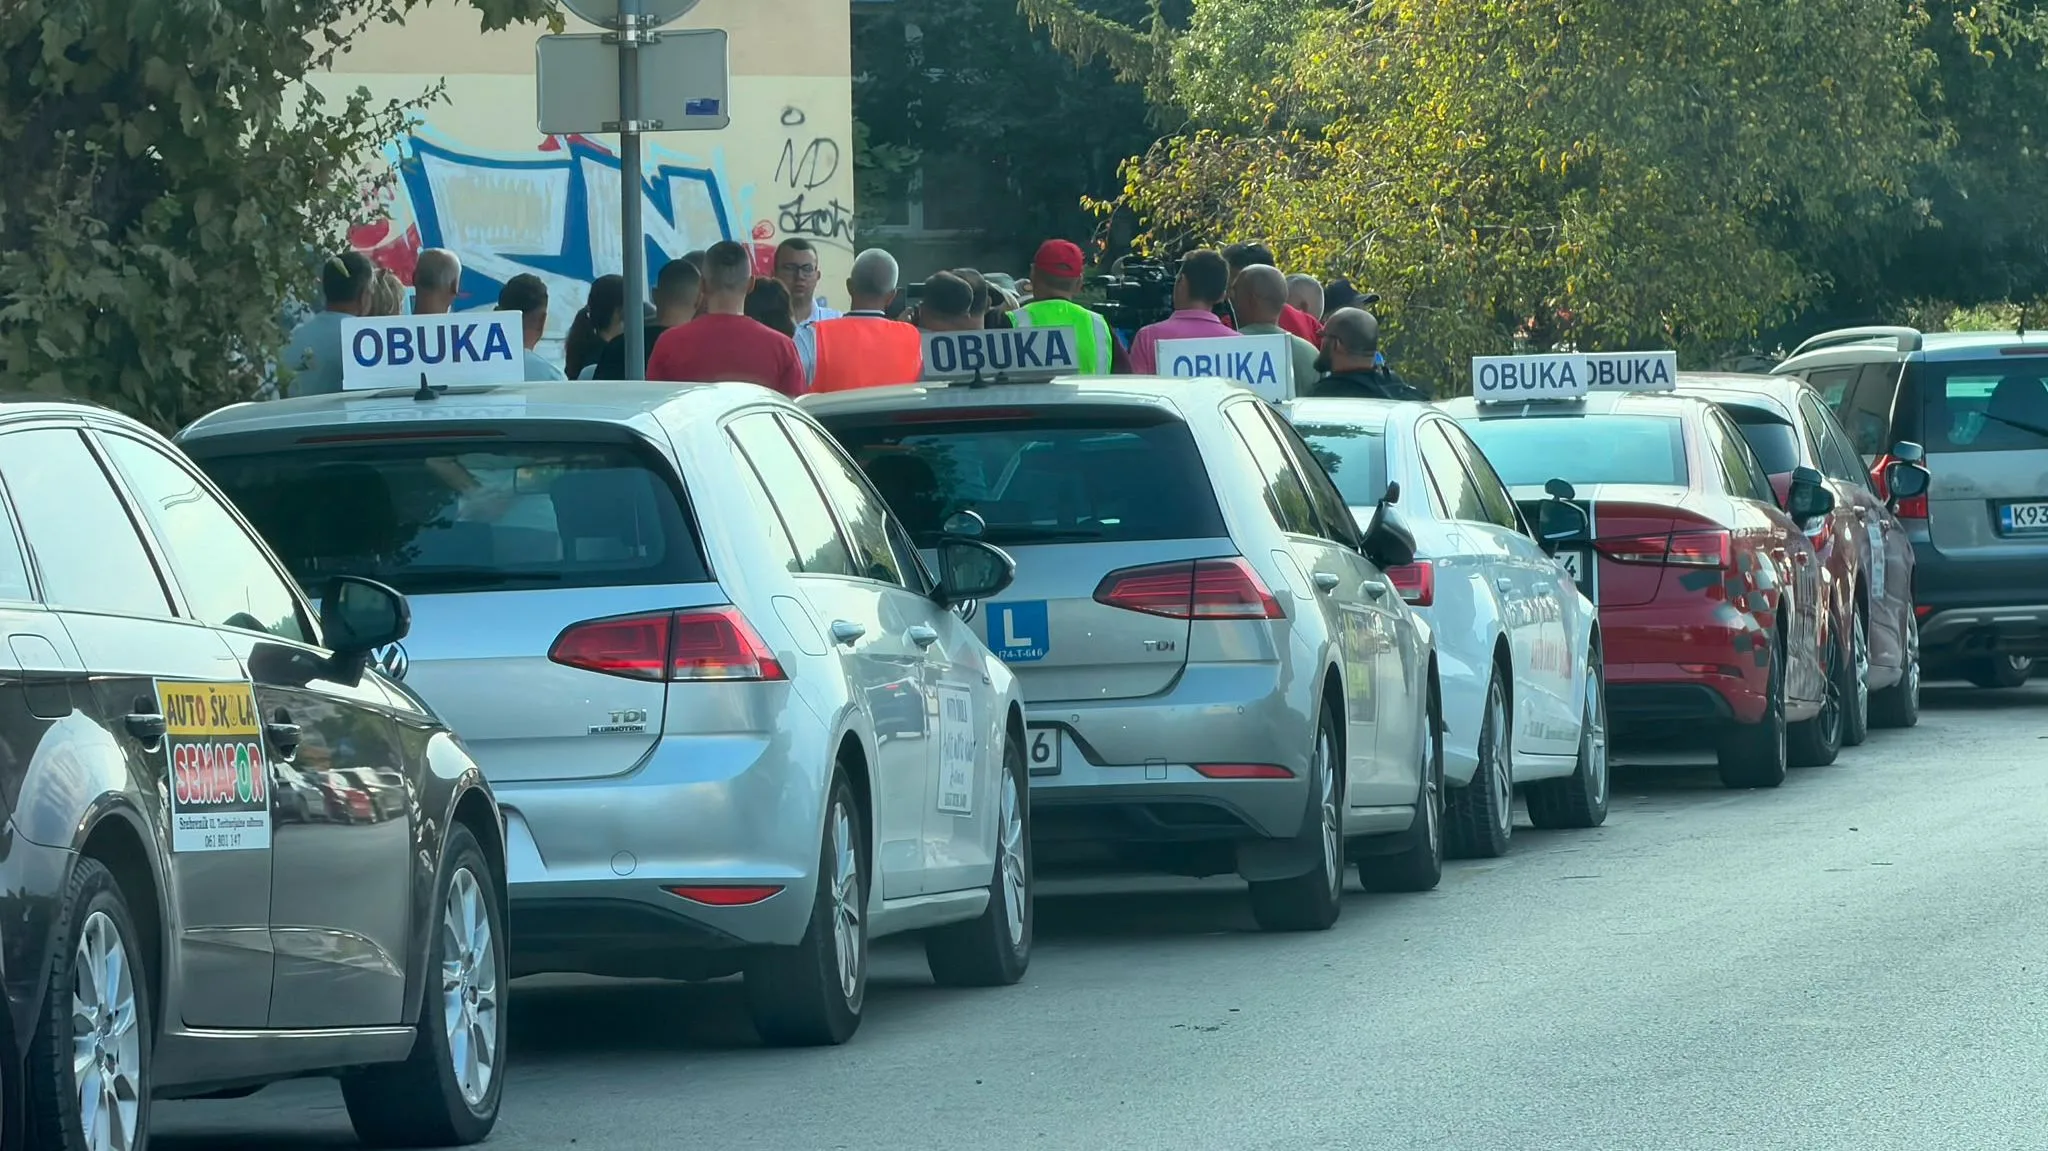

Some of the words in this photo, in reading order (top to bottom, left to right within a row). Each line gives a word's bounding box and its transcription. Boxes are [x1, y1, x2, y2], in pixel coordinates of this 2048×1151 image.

[352, 323, 513, 367] OBUKA
[930, 330, 1072, 372] OBUKA
[1173, 351, 1277, 384] OBUKA
[1479, 360, 1577, 391] OBUKA
[2014, 506, 2048, 525] K93
[1003, 608, 1032, 647] L
[1143, 640, 1175, 652] TDI
[167, 693, 207, 727] AUTO
[210, 686, 257, 728] ŠKOLA
[608, 707, 647, 723] TDI
[1031, 731, 1050, 763] 6
[174, 742, 265, 805] SEMAFOR
